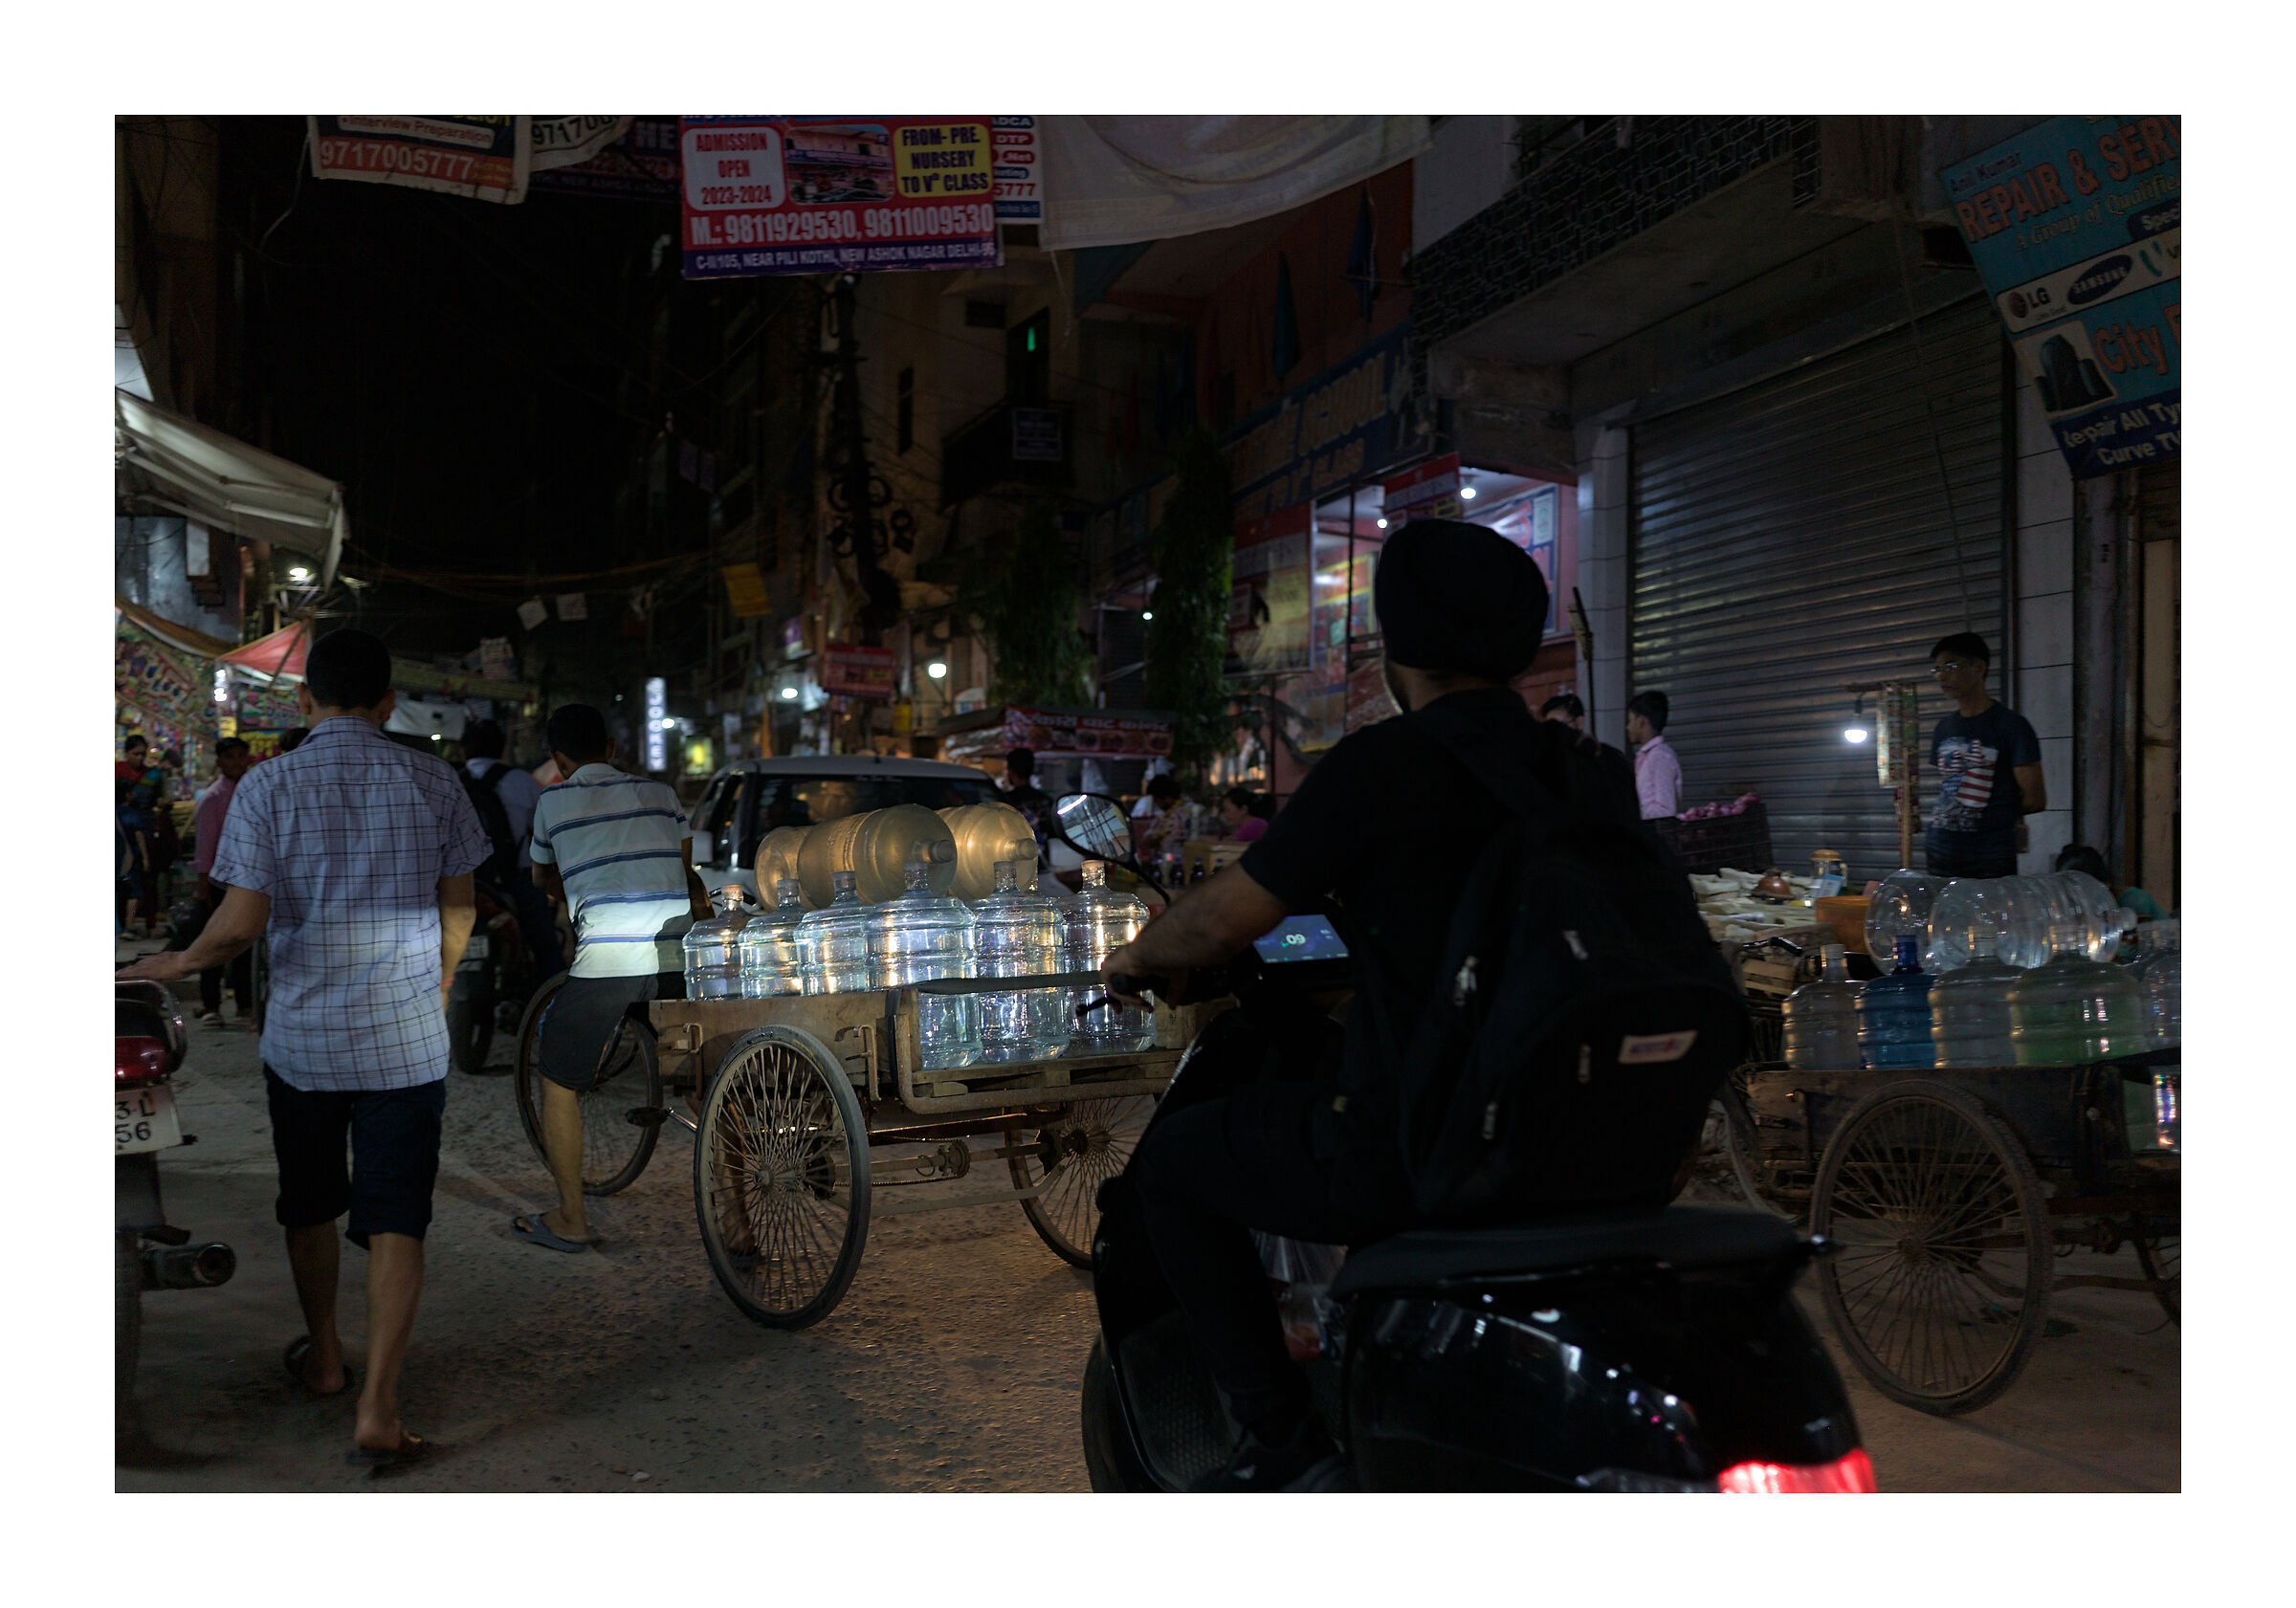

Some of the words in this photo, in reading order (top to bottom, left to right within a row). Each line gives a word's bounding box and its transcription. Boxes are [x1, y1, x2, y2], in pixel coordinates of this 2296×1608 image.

[413, 121, 492, 143] Preparation
[696, 133, 768, 152] ADMISSION
[902, 127, 947, 146] FROM-
[996, 134, 1029, 144] DTP
[320, 141, 475, 180] 9717005777
[718, 159, 751, 179] OPEN
[911, 150, 976, 169] NURSERY
[901, 176, 921, 194] TO
[943, 172, 989, 192] CLASS
[994, 184, 1035, 196] 5777
[701, 185, 773, 206] 2023-2024
[1955, 162, 2071, 244] REPAIR
[2065, 148, 2102, 196] &
[863, 203, 994, 239] 9811009530
[2030, 212, 2081, 246] Group
[742, 252, 776, 268] NEAR
[840, 247, 866, 263] NEW
[867, 246, 906, 262] ASHOK
[907, 244, 946, 260] NAGAR
[2026, 287, 2051, 308] LG
[2093, 320, 2170, 377] City
[2119, 408, 2151, 432] All
[2096, 443, 2157, 466] Curve
